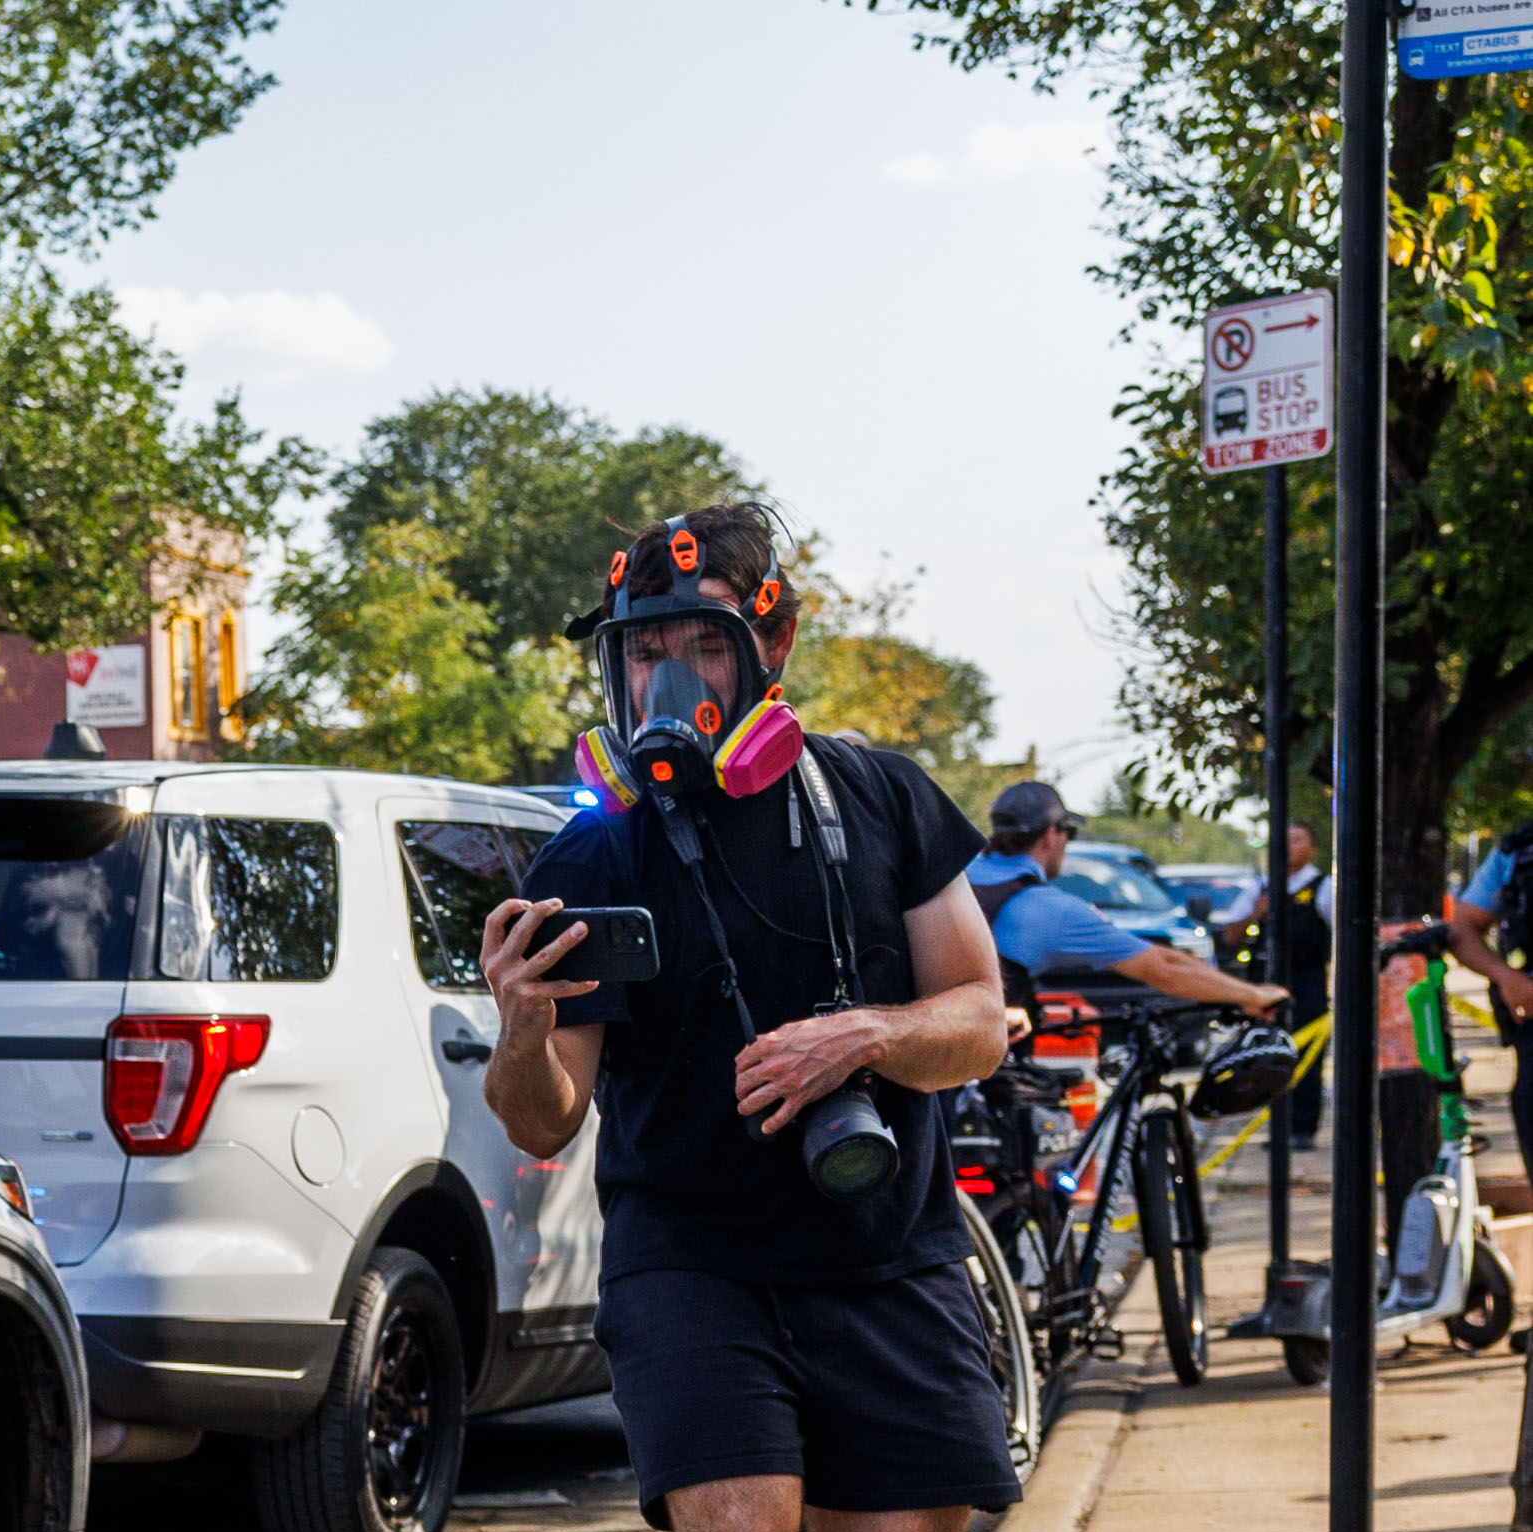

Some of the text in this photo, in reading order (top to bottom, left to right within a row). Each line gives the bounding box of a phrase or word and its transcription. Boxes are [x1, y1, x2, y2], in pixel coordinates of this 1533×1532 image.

[1451, 5, 1474, 16] CTA
[1477, 4, 1510, 13] buses
[1466, 35, 1520, 50] CTABUS
[1257, 373, 1306, 403] BUS
[1257, 399, 1320, 431] STOP
[1213, 432, 1319, 466] TOW ZONE
